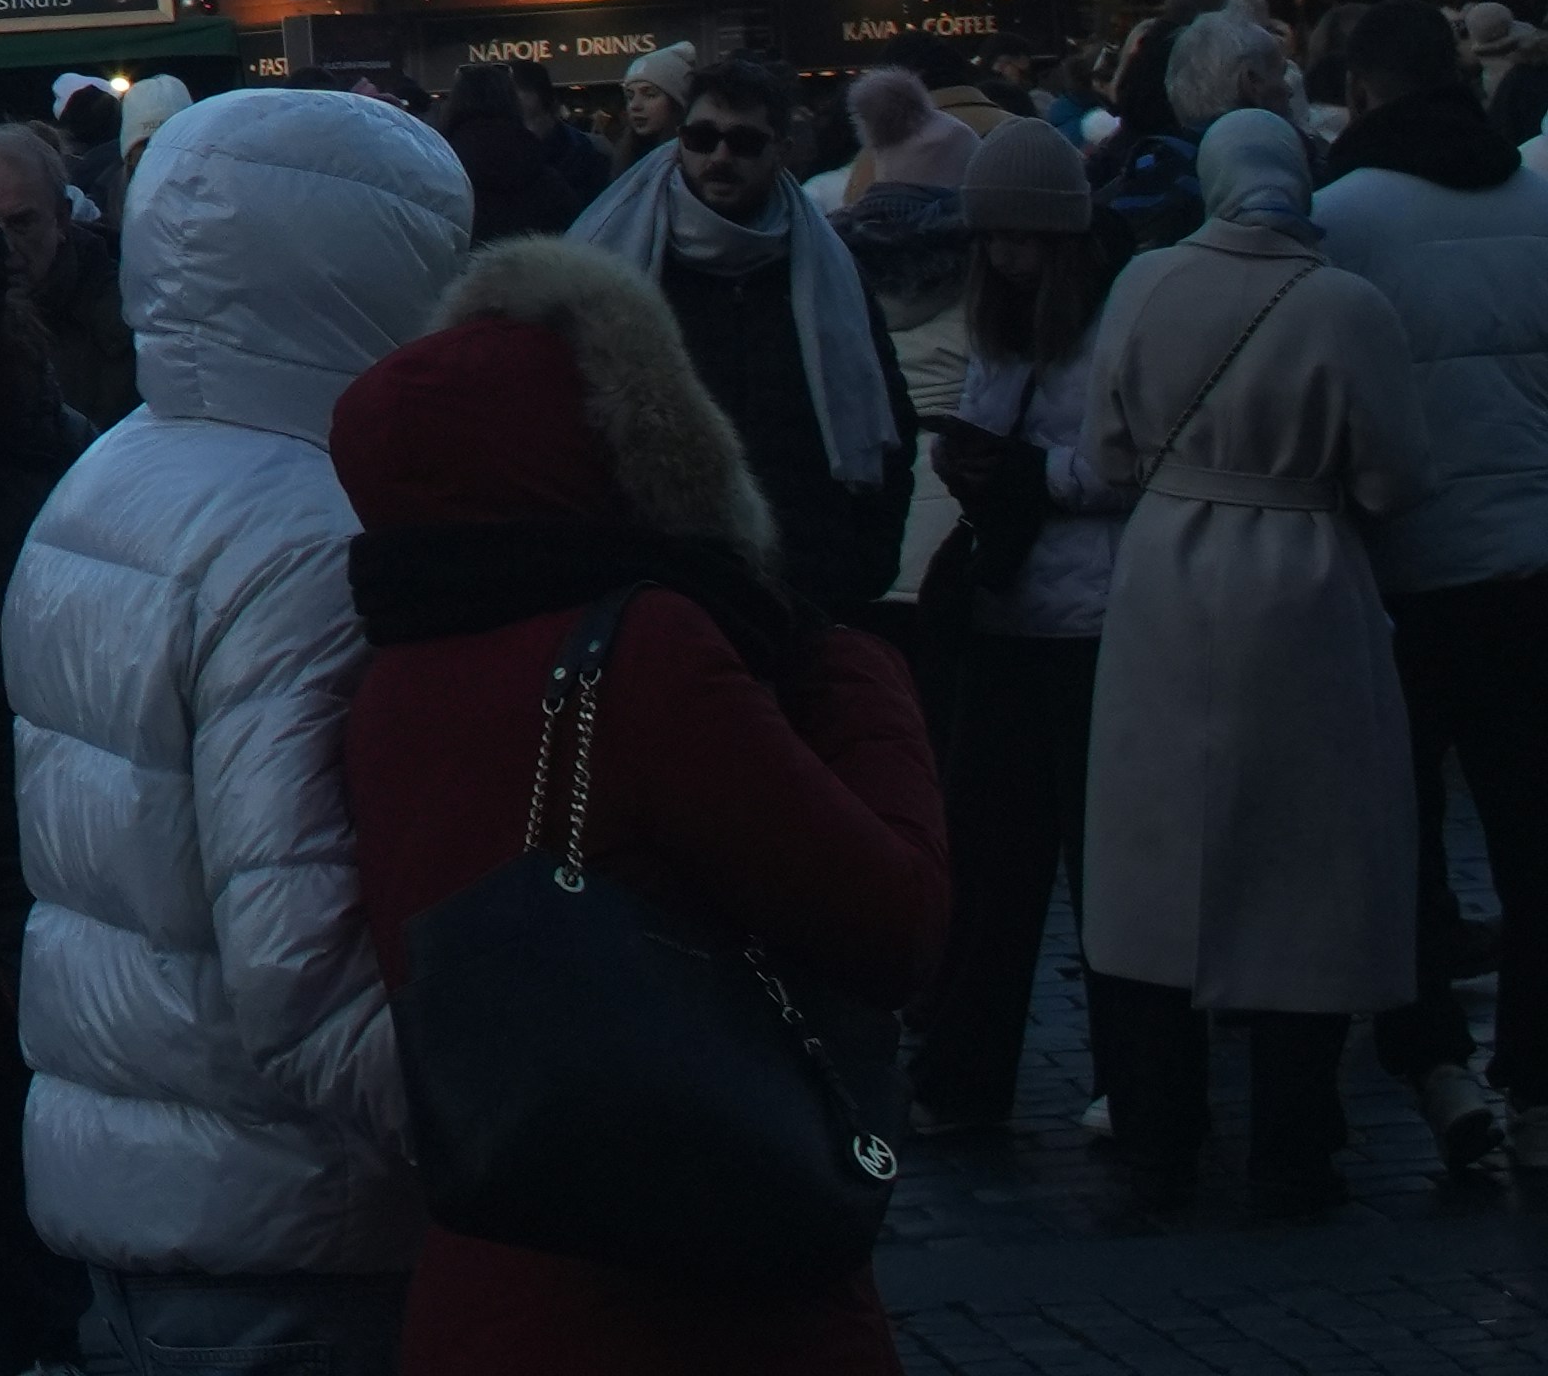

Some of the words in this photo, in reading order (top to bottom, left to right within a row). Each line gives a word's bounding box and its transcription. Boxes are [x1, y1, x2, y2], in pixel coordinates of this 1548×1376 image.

[922, 14, 999, 36] COFFEE
[469, 38, 553, 63] NÁPOJE
[576, 34, 657, 56] DRINKS
